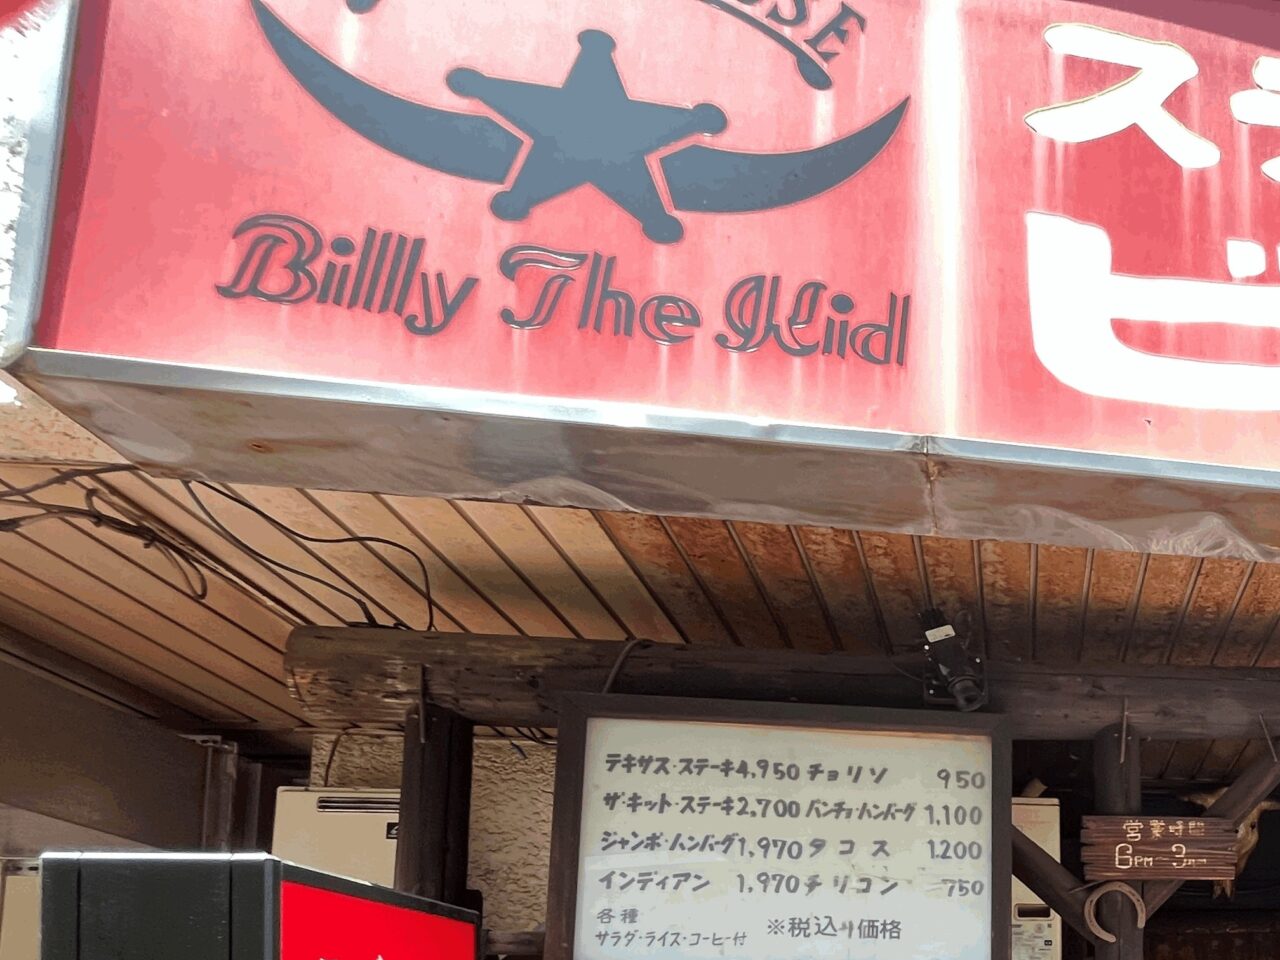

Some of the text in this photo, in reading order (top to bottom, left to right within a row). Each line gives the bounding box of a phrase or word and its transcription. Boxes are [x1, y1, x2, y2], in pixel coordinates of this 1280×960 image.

[215, 213, 912, 367] Billy The Kid
[735, 758, 801, 781] 4,950
[807, 763, 986, 790] チョリソ 950
[736, 796, 801, 818] 2,700
[924, 804, 983, 826] 1,100
[738, 836, 803, 860] 1,970
[808, 838, 891, 858] タコス
[598, 870, 801, 894] インディアン 1,970
[941, 878, 985, 898] 750
[596, 907, 640, 925] 各種
